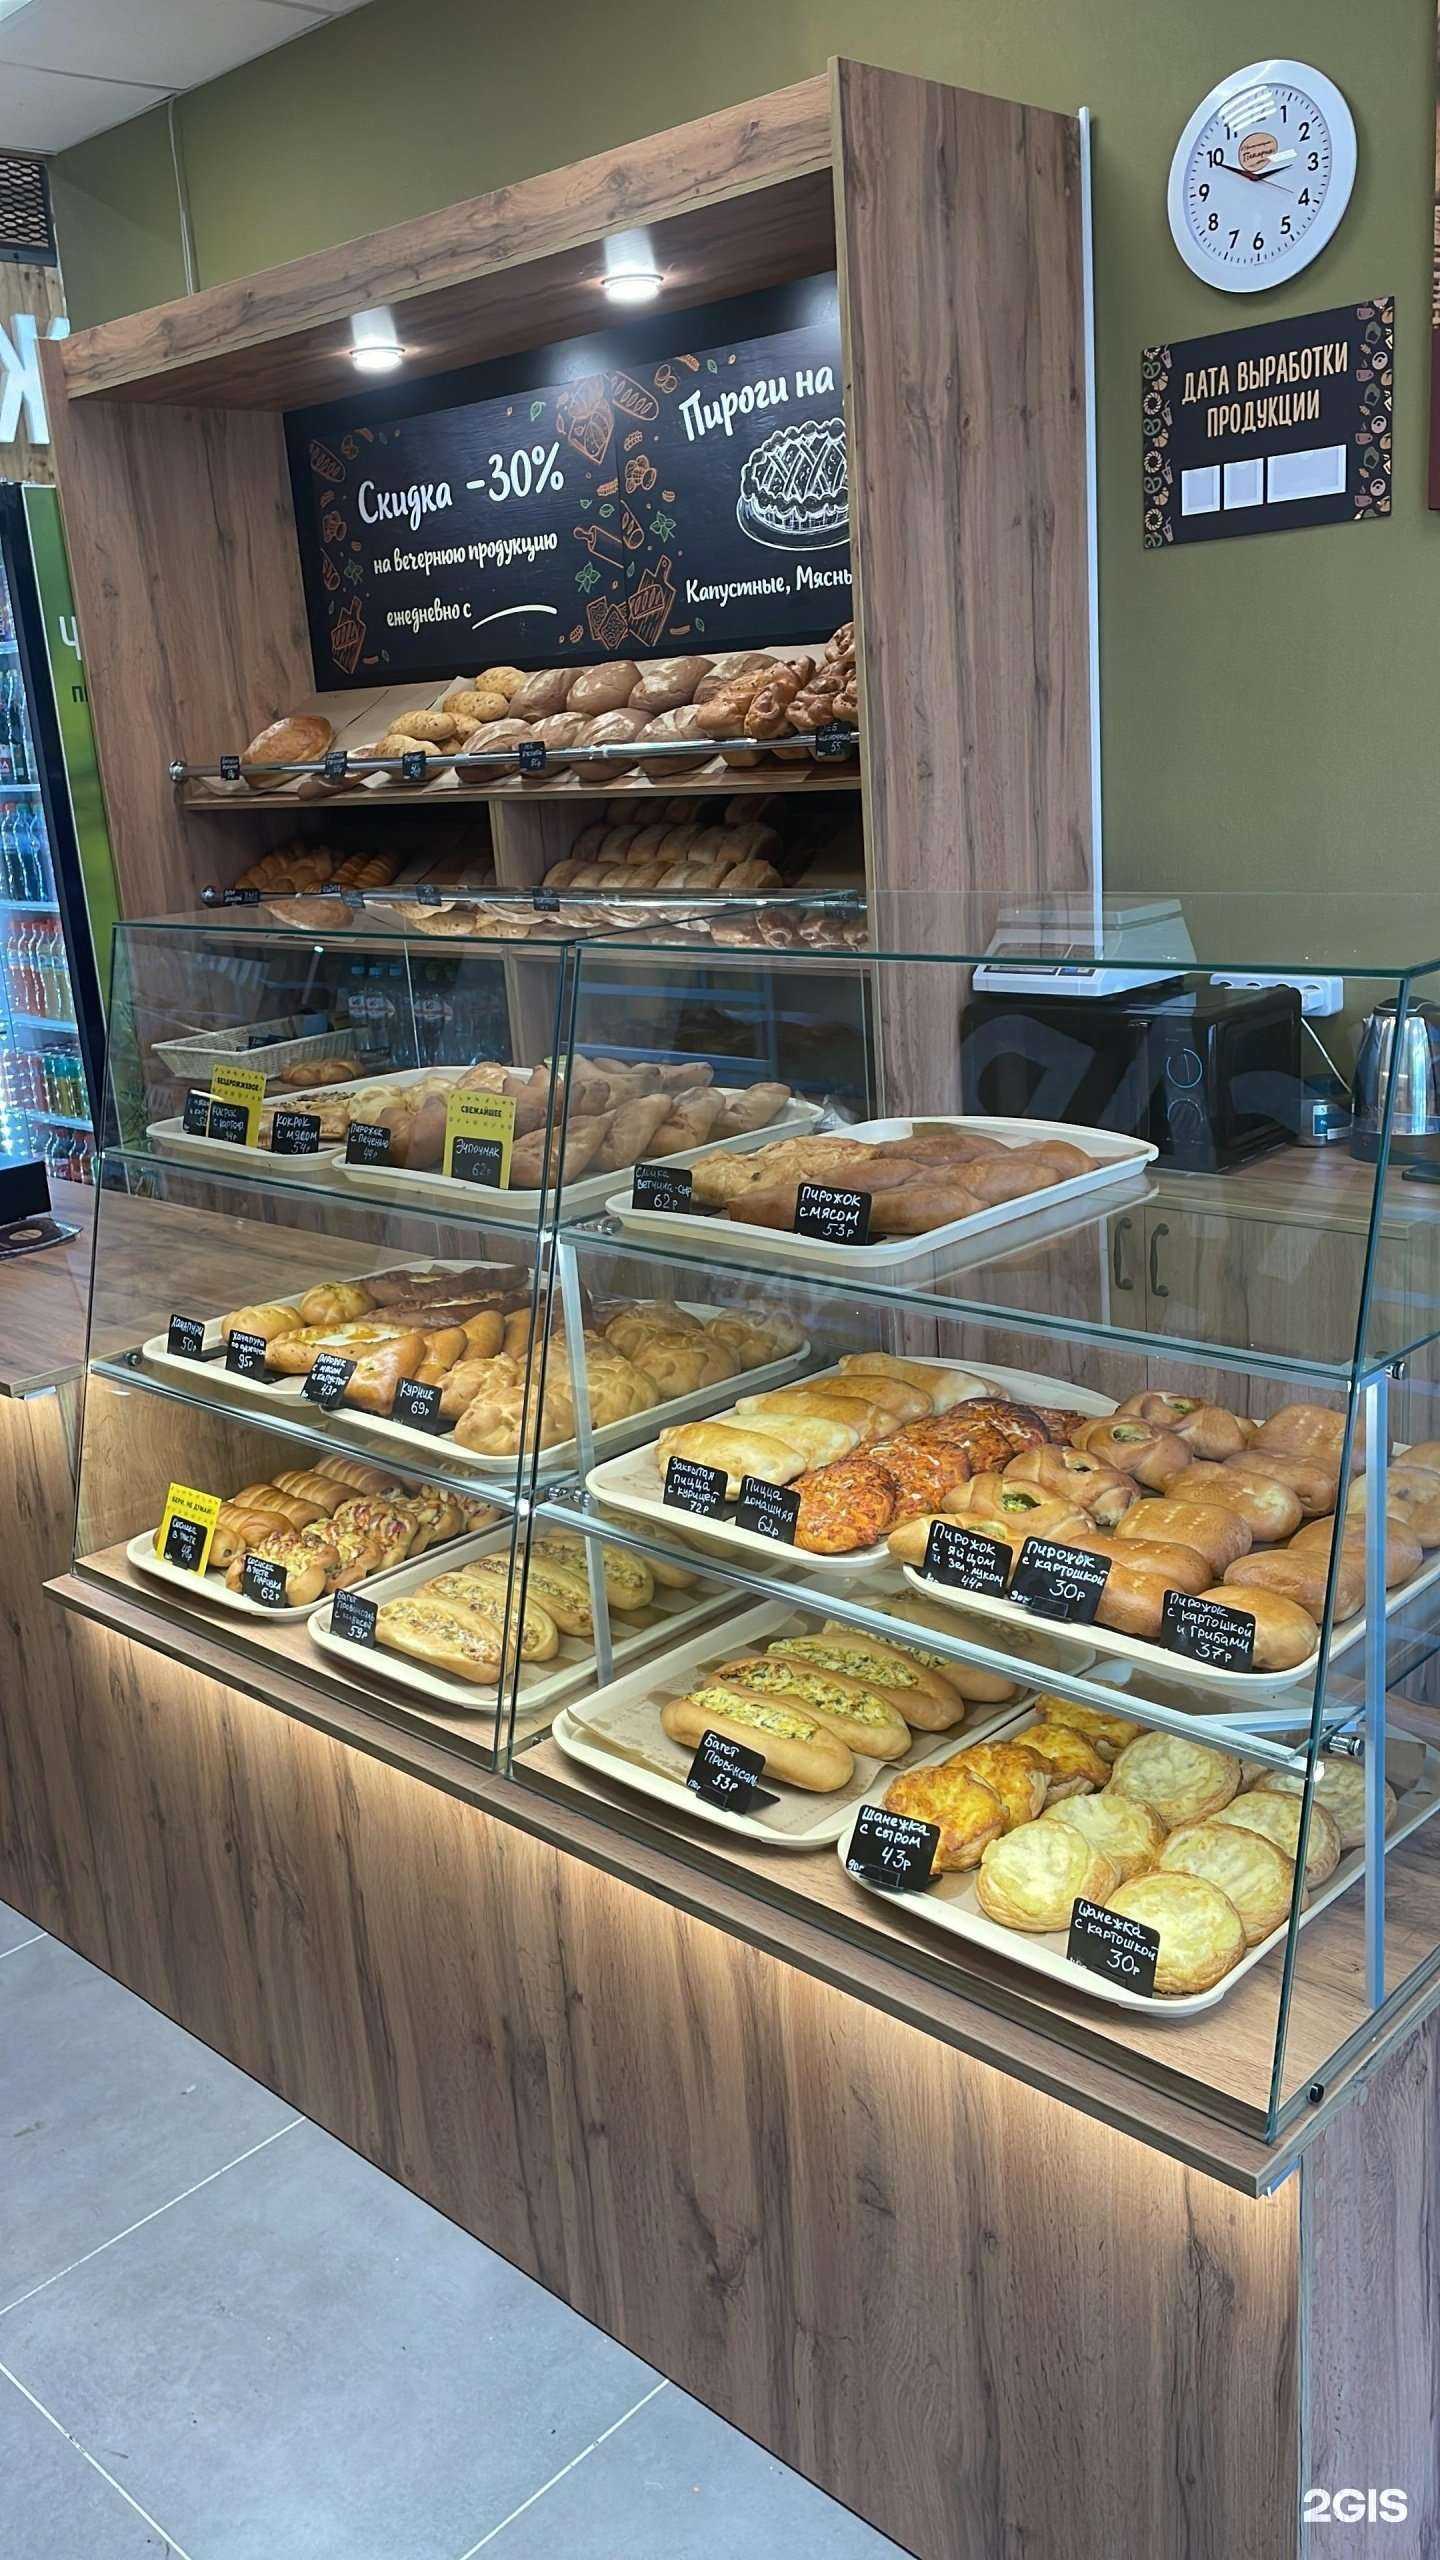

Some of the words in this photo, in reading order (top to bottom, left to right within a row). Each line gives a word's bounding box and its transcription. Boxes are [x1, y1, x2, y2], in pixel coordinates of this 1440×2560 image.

[1280, 105, 1287, 123] 1
[1298, 122, 1311, 142] 2
[1207, 148, 1224, 168] 10
[1307, 152, 1319, 171] 3
[1199, 183, 1210, 202] 9
[1298, 188, 1311, 206] 4
[1208, 213, 1219, 231] 8
[1280, 216, 1291, 235] 5
[1229, 230, 1240, 249] 7
[1253, 232, 1264, 250] 6
[1182, 365, 1230, 405] ДАТА
[1237, 342, 1348, 392] ВЫРАБОТКИ
[679, 376, 789, 441] Пироги
[796, 366, 835, 398] на
[1207, 389, 1320, 437] ПРОДУКЦИИ
[358, 480, 453, 531] Скидка
[466, 441, 564, 501] -30%
[374, 558, 391, 574] на
[394, 548, 465, 576] вечернюю
[468, 533, 558, 568] продукцию
[686, 576, 791, 607] Капустные,
[387, 598, 460, 633] ежедневно
[463, 602, 472, 618] с
[461, 1105, 502, 1117] СВЕЖАЙШЕЕ
[802, 1186, 861, 1207] Пирожок
[822, 1223, 855, 1238] 53р
[400, 1380, 435, 1401] Курник
[411, 1401, 430, 1415] 69р
[746, 1478, 783, 1501] Пицца
[689, 1501, 710, 1514] 72р
[757, 1515, 779, 1537] 62р
[933, 1523, 996, 1556] Пирожок
[932, 1543, 940, 1551] с
[947, 1545, 996, 1570] яйцом
[1027, 1540, 1096, 1568] Пирожок
[933, 1554, 941, 1564] и
[970, 1567, 1004, 1588] луком
[961, 1575, 983, 1589] 44р
[1022, 1556, 1030, 1564] с
[1034, 1559, 1108, 1586] картошкой
[1049, 1579, 1086, 1602] 30р
[1170, 1593, 1229, 1617] Пирожок
[1167, 1608, 1175, 1616] с
[1181, 1610, 1254, 1638] картошкой
[1176, 1625, 1185, 1635] и
[1195, 1642, 1232, 1662] 37р
[704, 1733, 740, 1758] Багет
[712, 1773, 739, 1791] 53р
[862, 1807, 930, 1836] Шанежка
[859, 1823, 869, 1834] с
[875, 1827, 921, 1848] сыром
[881, 1846, 912, 1871] 43р
[1079, 1901, 1146, 1939] Шанежка
[1074, 1918, 1083, 1929] с
[1087, 1922, 1159, 1961] картошкой
[1106, 1948, 1140, 1976] 30р
